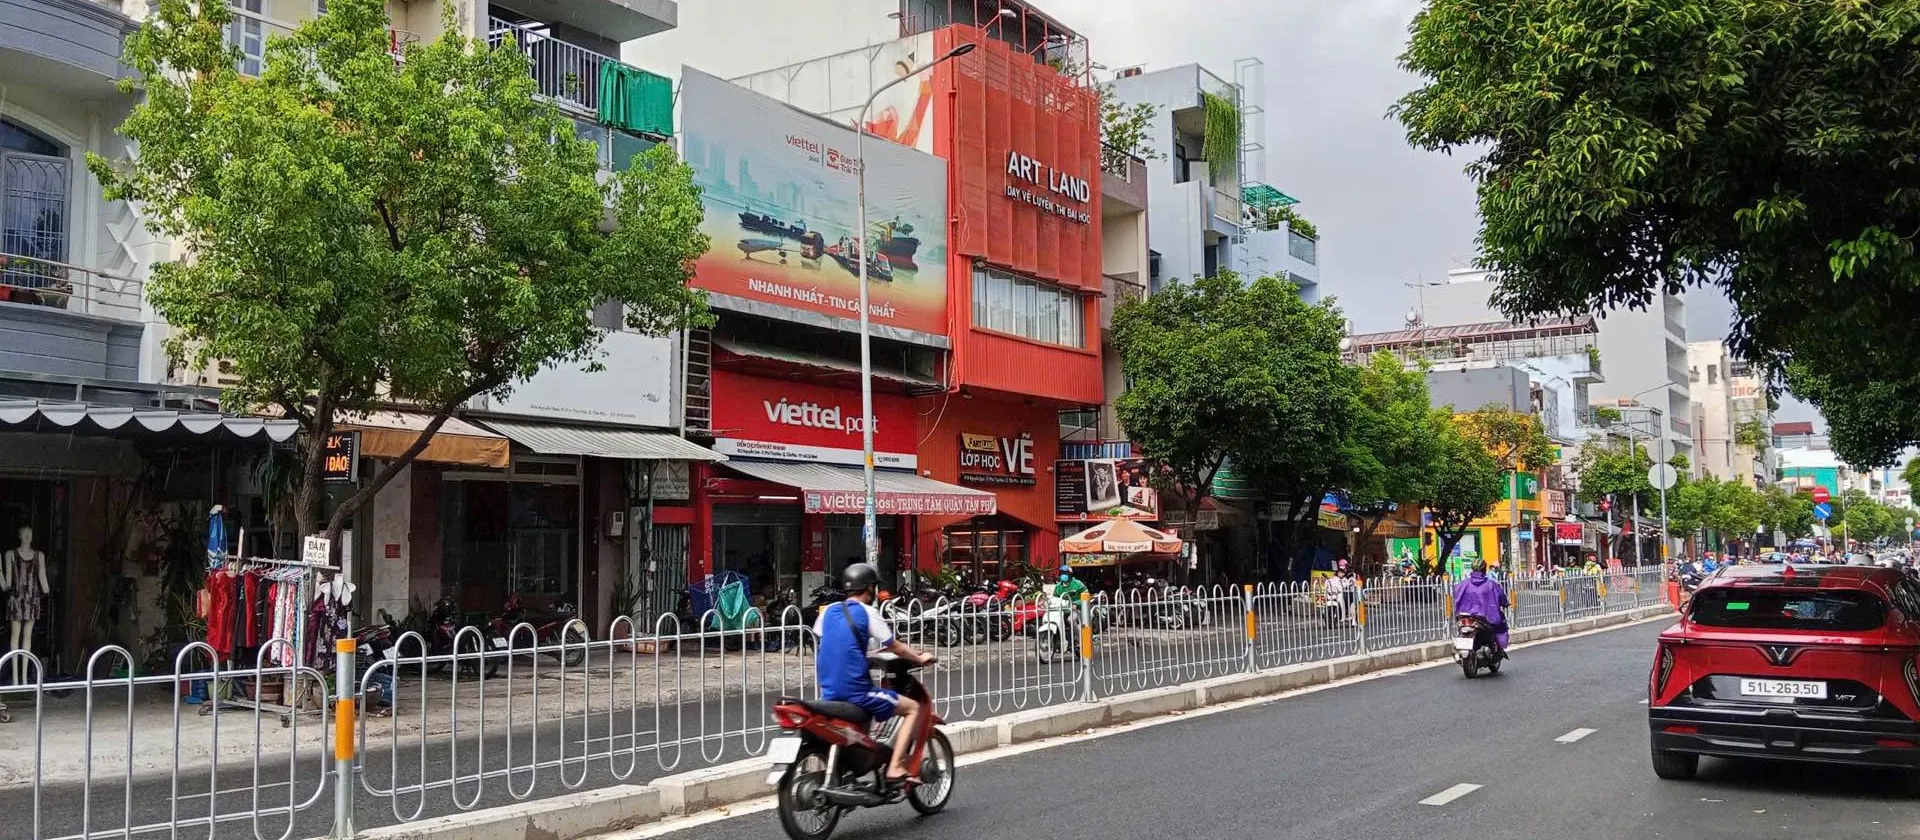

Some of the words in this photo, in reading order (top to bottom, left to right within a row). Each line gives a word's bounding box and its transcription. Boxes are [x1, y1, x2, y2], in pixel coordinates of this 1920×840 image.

[785, 134, 820, 155] viettel
[1007, 150, 1042, 185] ART
[1047, 166, 1090, 204] LAND
[748, 278, 791, 298] NHANH
[847, 298, 862, 315] CẬ
[868, 301, 896, 318] NHẤT
[763, 397, 845, 430] viettel
[845, 415, 879, 436] pot
[960, 449, 980, 467] LỚP
[981, 453, 1001, 472] HỌC
[1002, 432, 1036, 475] VẼ
[822, 492, 865, 509] viette
[897, 499, 923, 511] TRUNG
[1748, 681, 1819, 695] 51L-263.50
